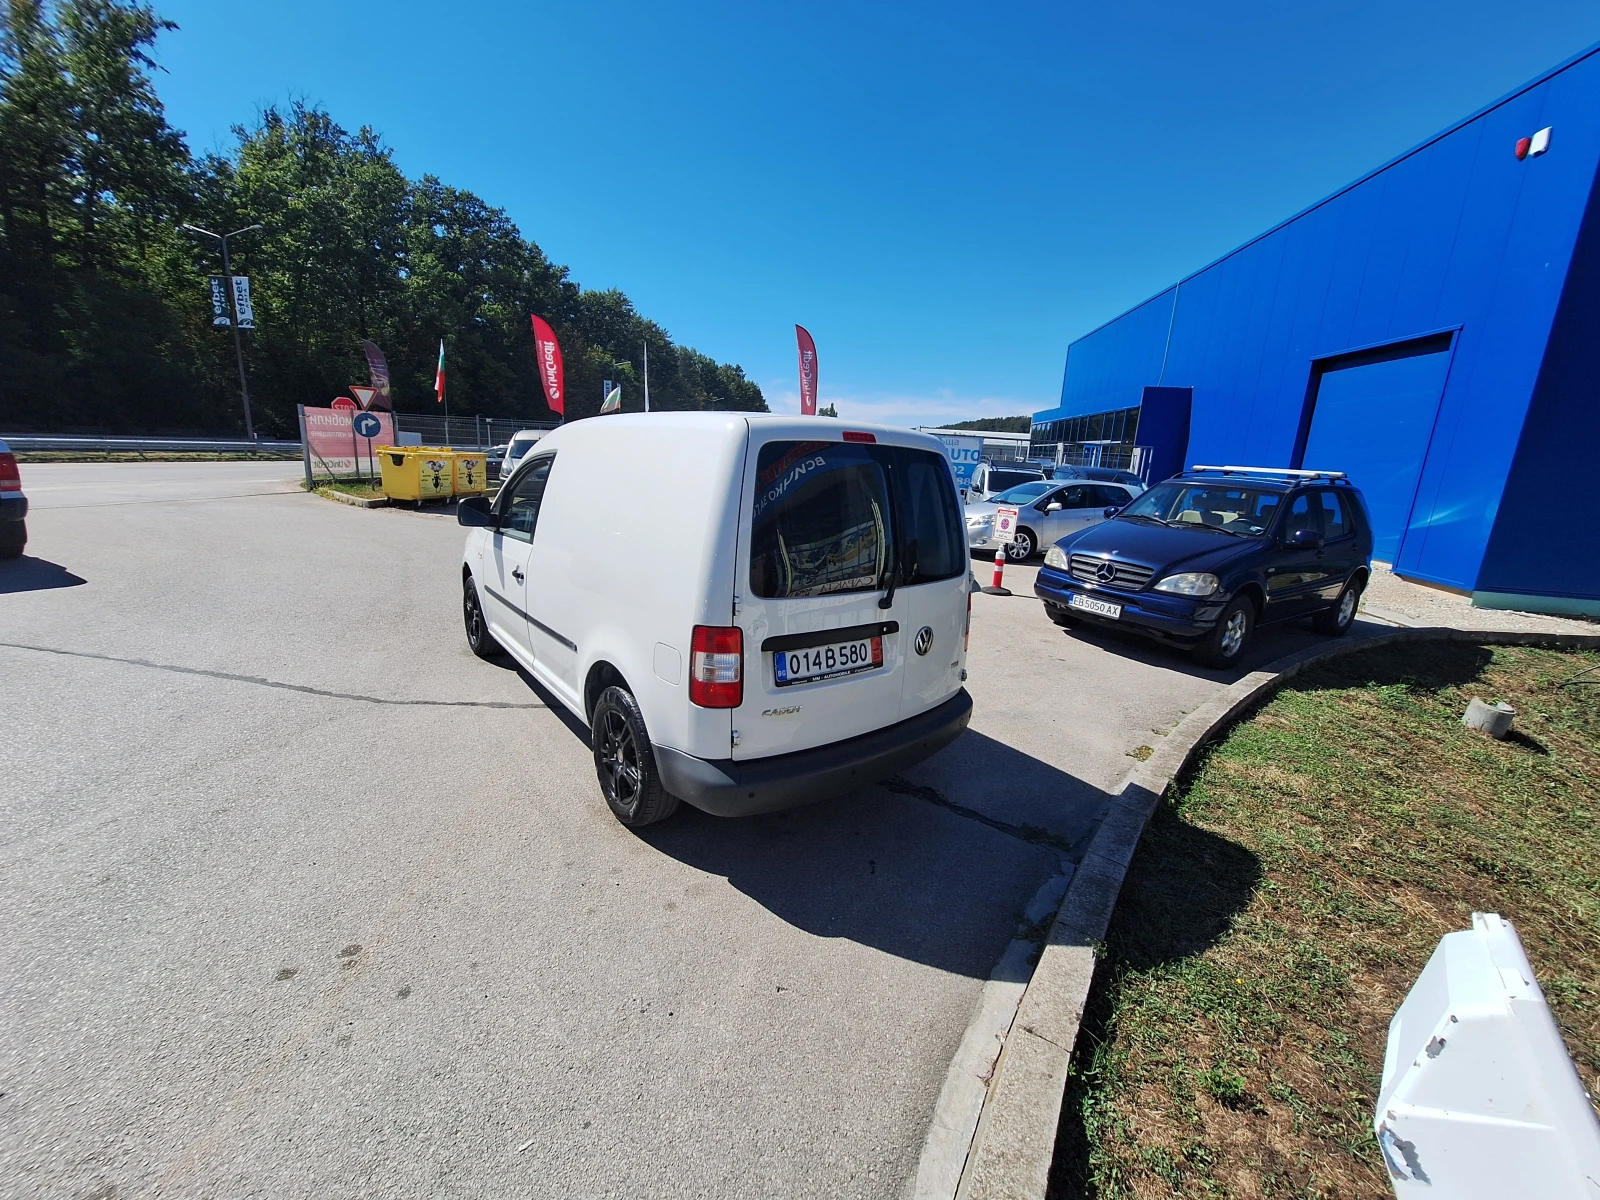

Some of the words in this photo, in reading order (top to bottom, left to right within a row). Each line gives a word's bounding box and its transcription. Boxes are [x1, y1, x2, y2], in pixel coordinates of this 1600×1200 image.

[211, 278, 222, 315] efbet
[235, 279, 246, 315] efbet
[949, 448, 981, 462] UTO
[1084, 599, 1106, 612] 5050
[777, 669, 787, 677] BG
